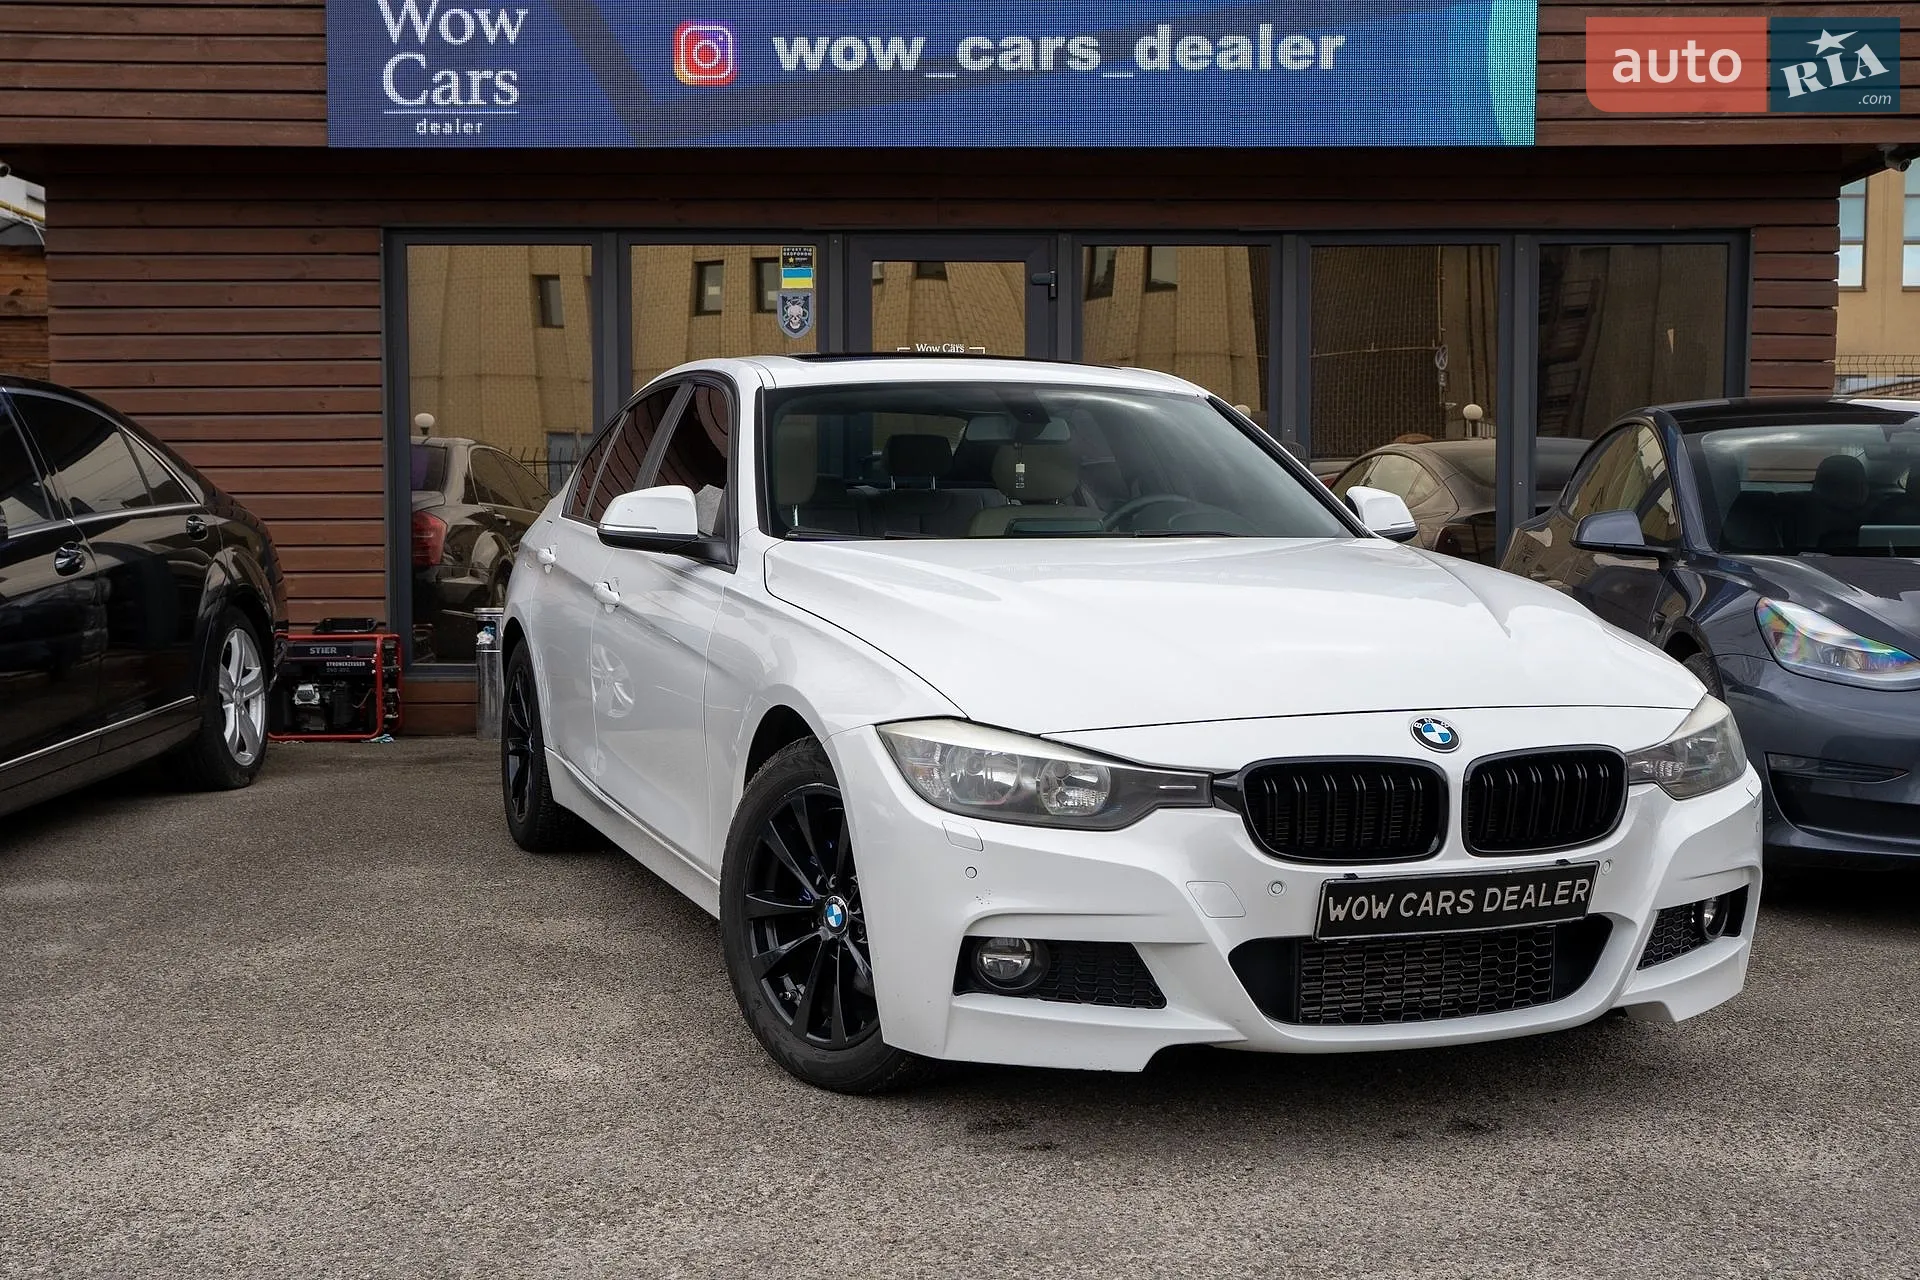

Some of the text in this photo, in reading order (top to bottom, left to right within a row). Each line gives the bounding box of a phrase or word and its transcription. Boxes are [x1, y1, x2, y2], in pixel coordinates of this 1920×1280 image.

[376, 0, 529, 45] Wow
[772, 24, 1346, 78] wow_cars_dealer
[383, 52, 520, 105] Cars
[416, 118, 483, 135] dealer
[916, 343, 965, 353] Wow Cars
[1328, 878, 1590, 922] WOW CARS DEALER
